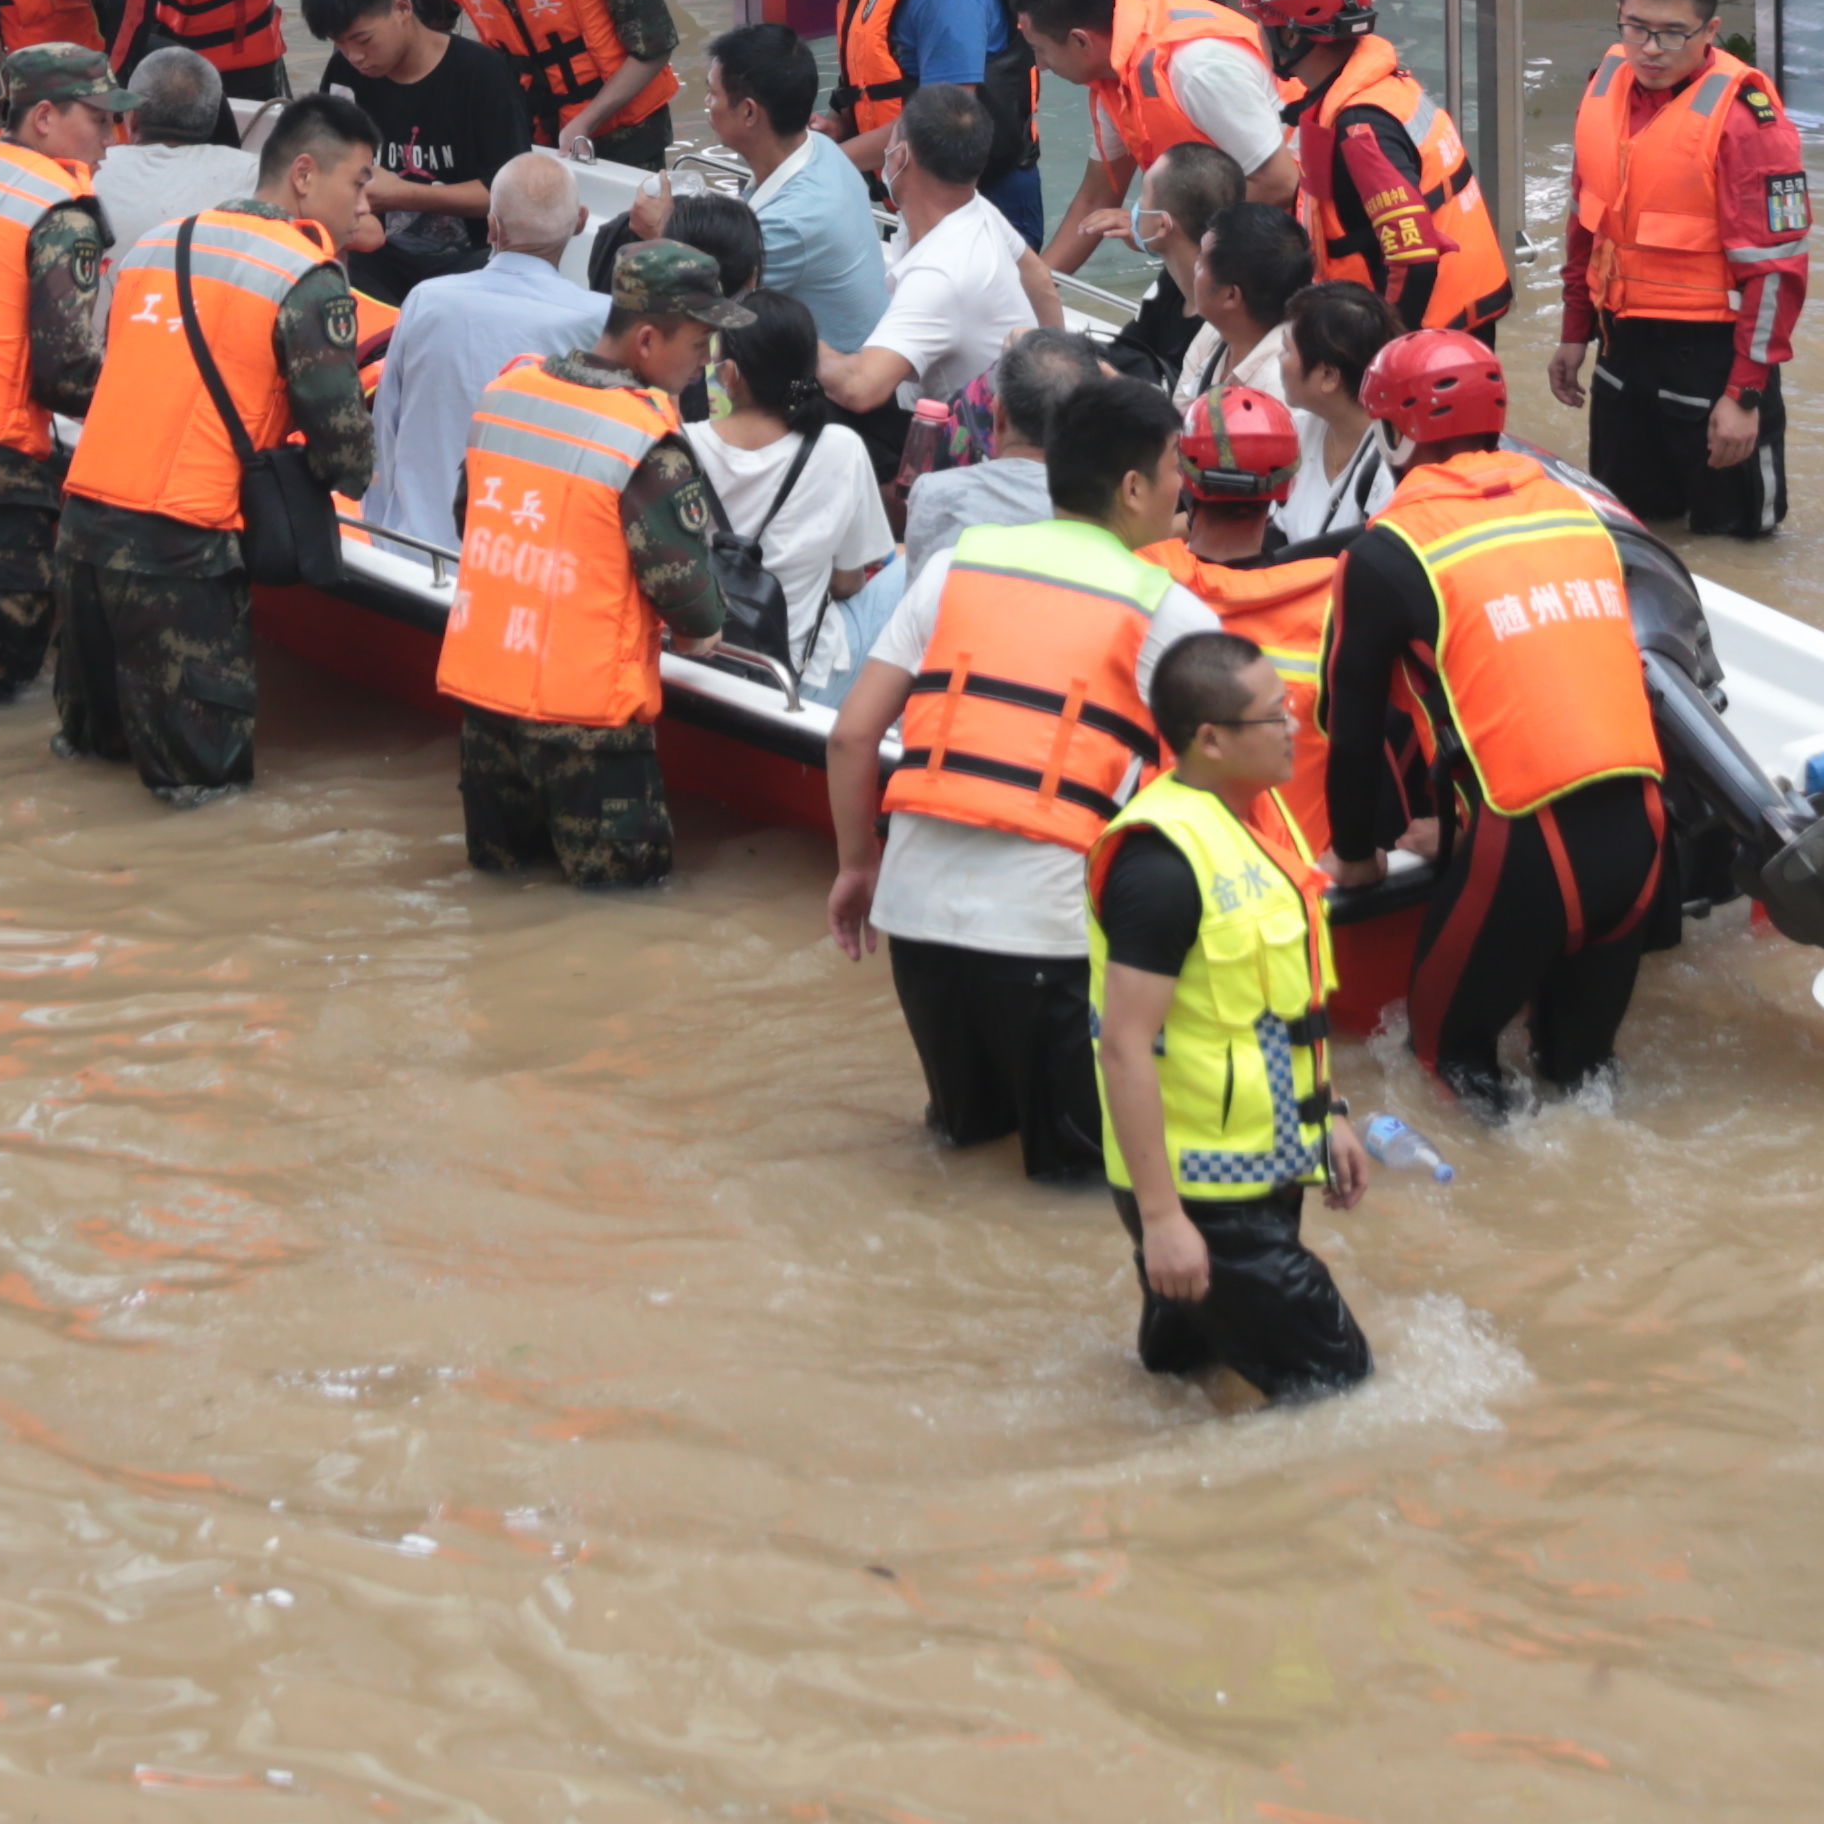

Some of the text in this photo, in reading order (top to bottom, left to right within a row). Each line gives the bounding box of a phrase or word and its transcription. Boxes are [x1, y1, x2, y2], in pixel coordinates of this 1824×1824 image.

[474, 476, 547, 533] 工兵
[1483, 576, 1626, 642] 随州消防
[1207, 860, 1273, 915] 金水
